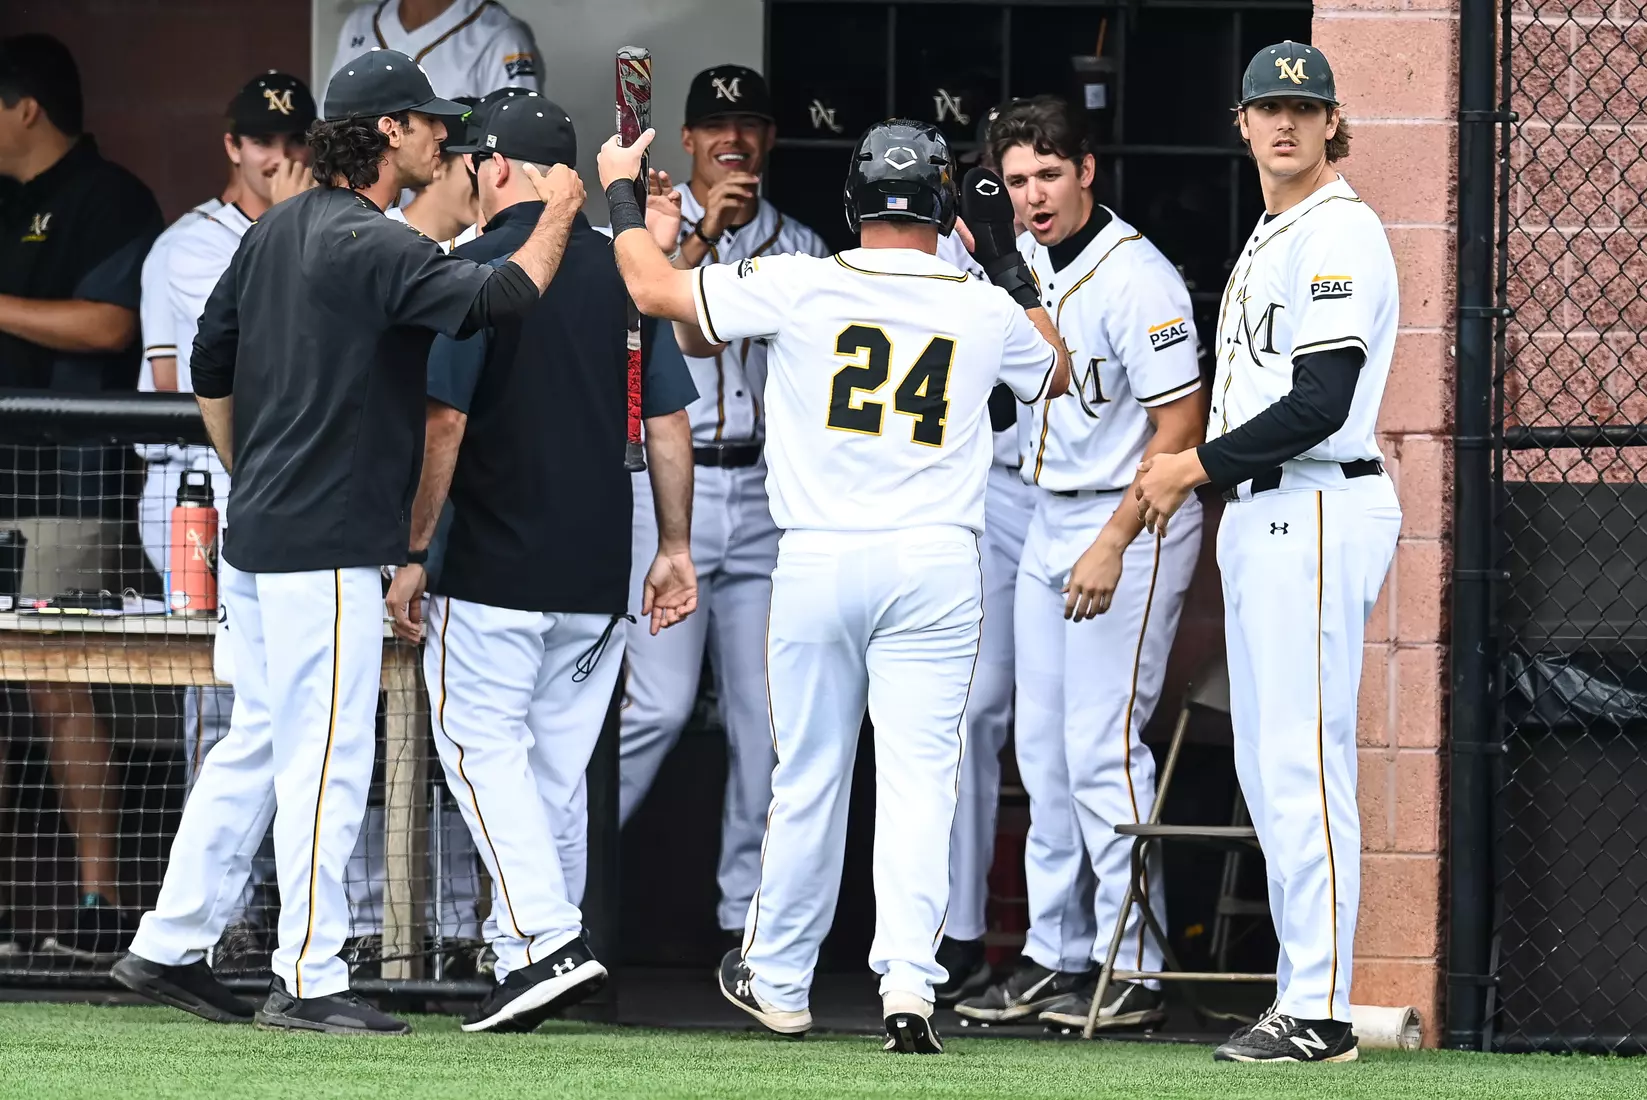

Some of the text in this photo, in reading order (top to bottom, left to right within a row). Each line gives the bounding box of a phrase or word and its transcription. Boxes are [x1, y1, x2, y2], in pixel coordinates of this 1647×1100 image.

[1275, 57, 1310, 85] M
[263, 88, 295, 115] M
[712, 76, 743, 103] M
[1310, 281, 1353, 296] PSAC
[1149, 322, 1188, 346] PSAC
[825, 322, 957, 449] 24
[1289, 1028, 1328, 1058] N
